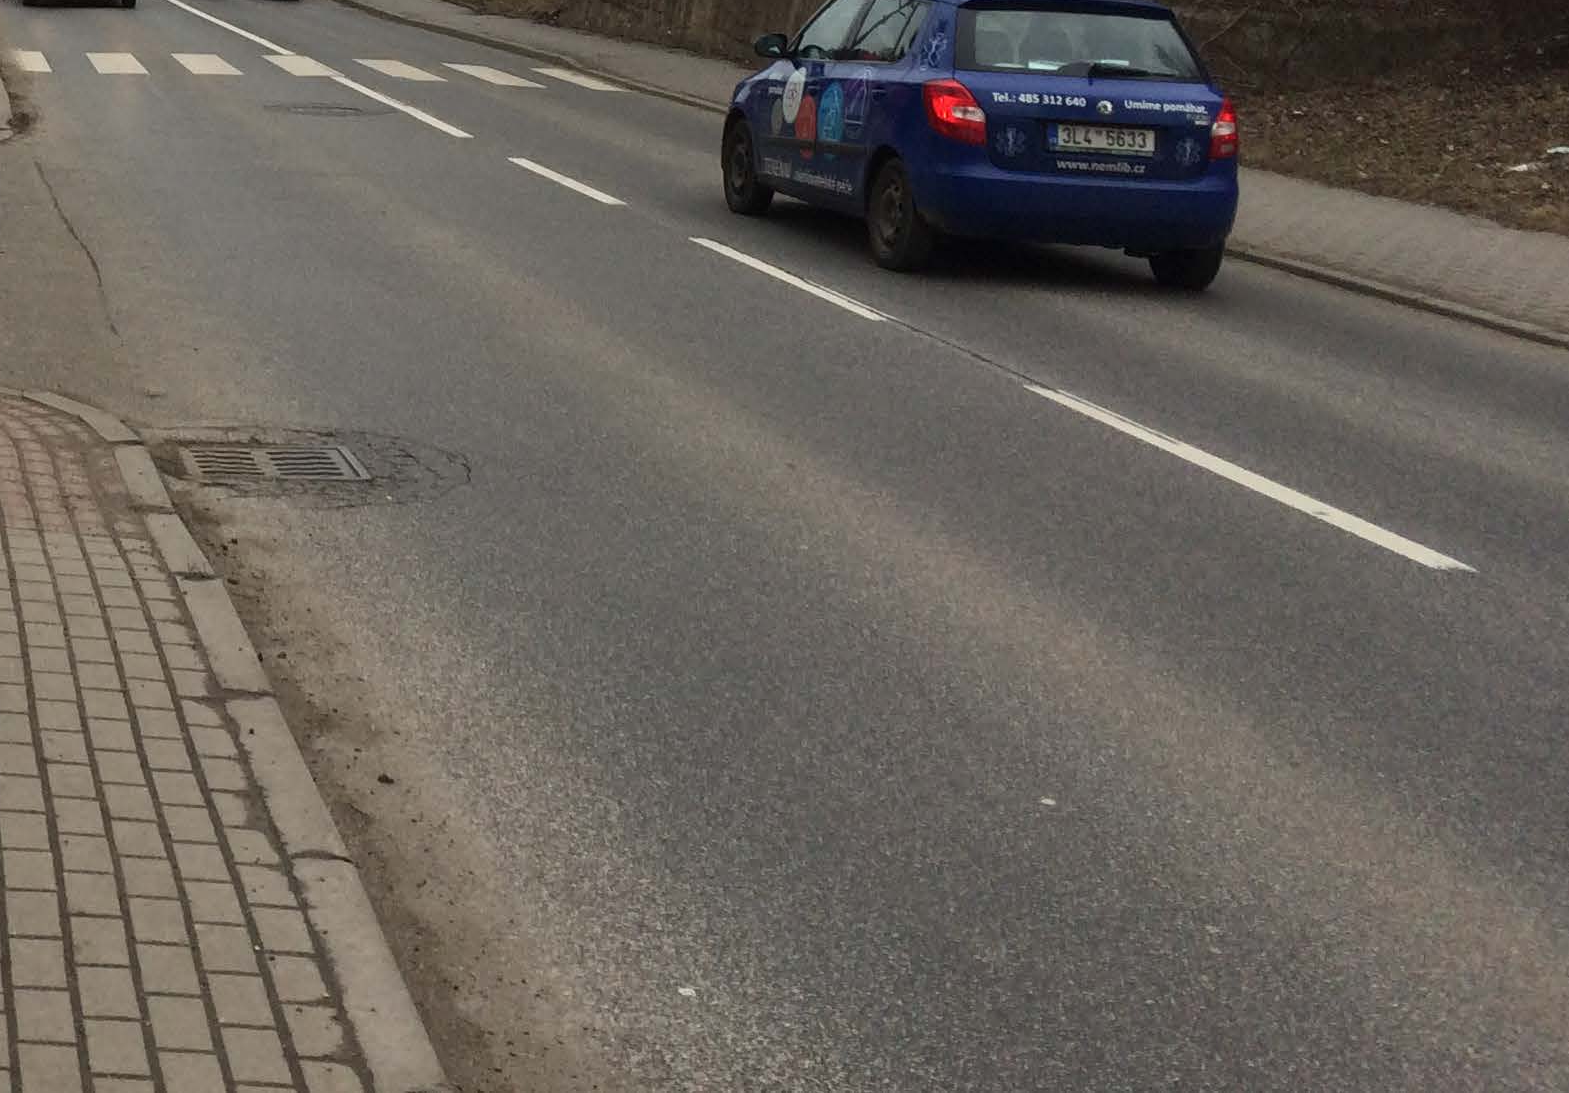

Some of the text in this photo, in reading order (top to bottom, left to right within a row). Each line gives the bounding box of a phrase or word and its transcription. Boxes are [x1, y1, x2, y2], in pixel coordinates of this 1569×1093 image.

[992, 92, 1087, 108] Tel.: 485 312 640
[1061, 127, 1148, 149] 3L4 5633
